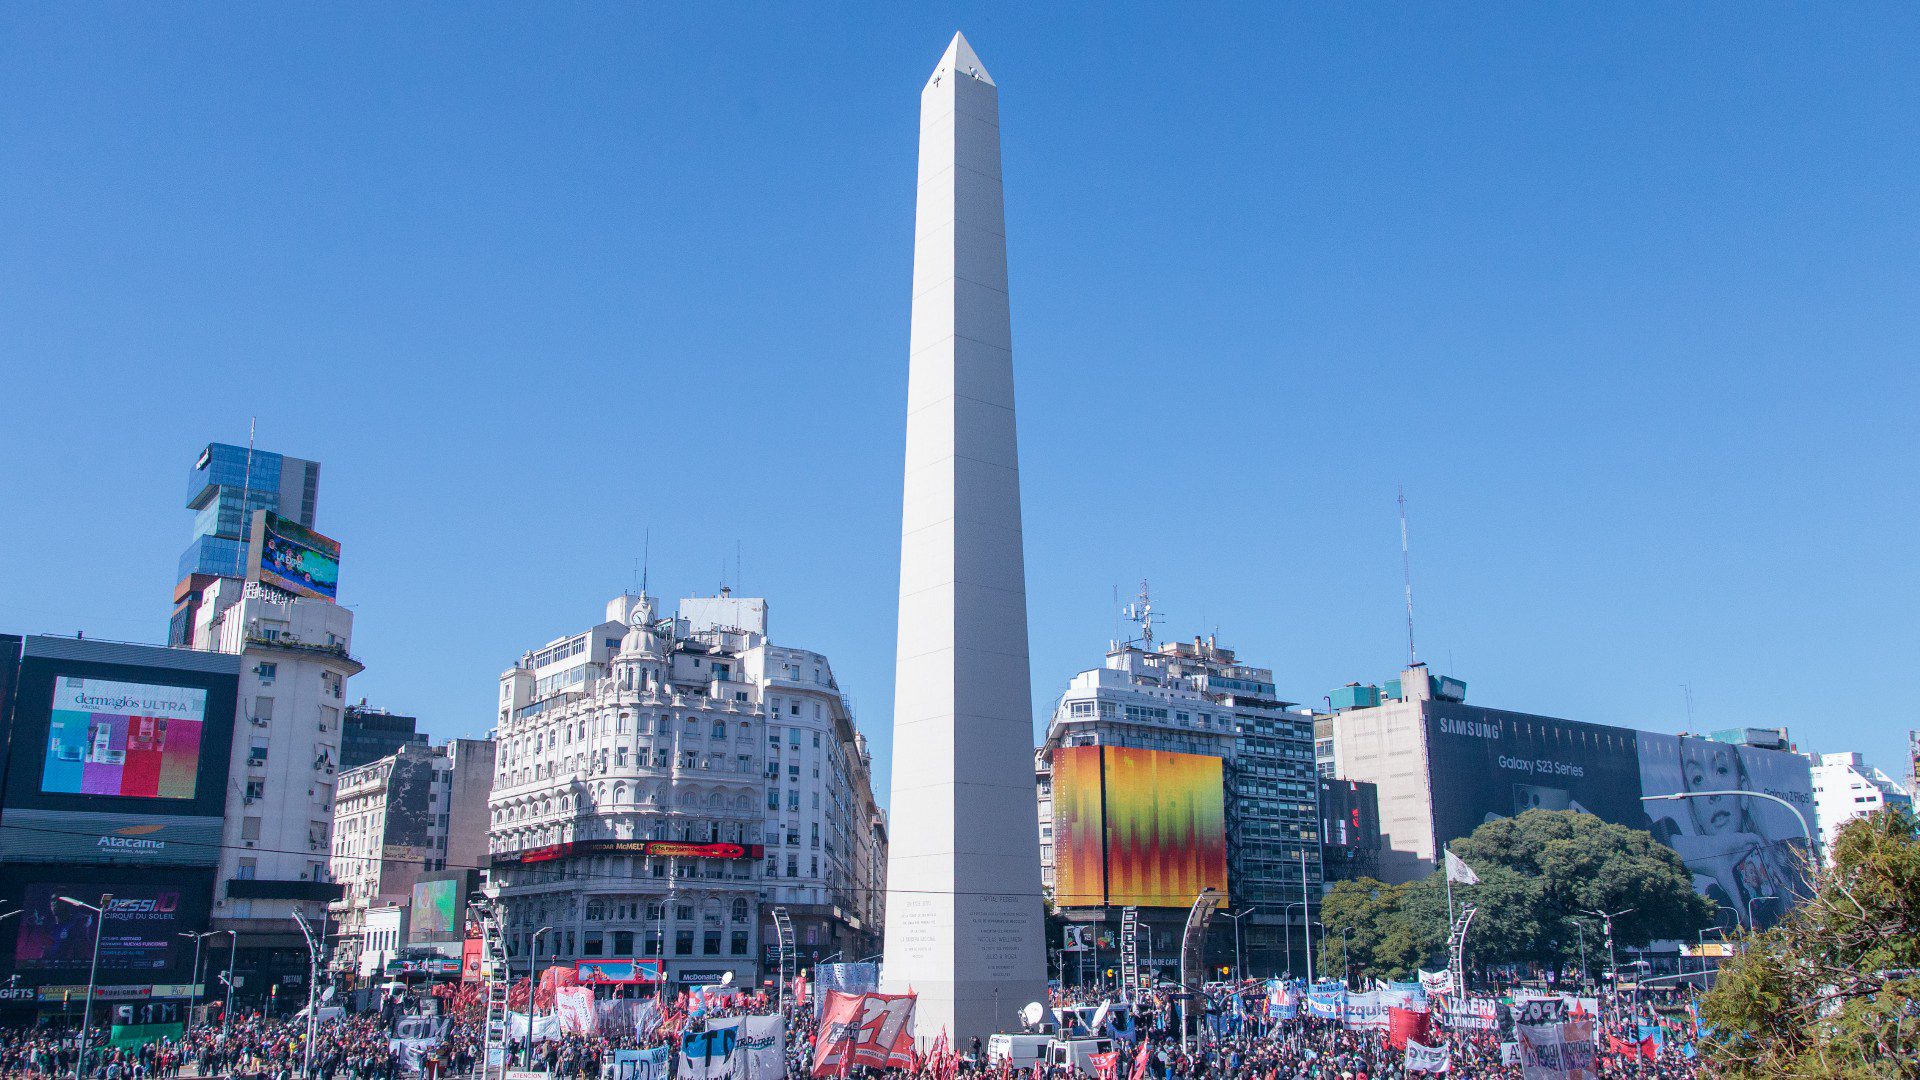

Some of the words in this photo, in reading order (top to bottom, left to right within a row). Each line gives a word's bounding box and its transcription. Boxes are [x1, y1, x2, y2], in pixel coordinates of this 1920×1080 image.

[143, 699, 188, 712] ULTRA
[1440, 717, 1499, 739] SAMSUNG
[1499, 755, 1534, 775] Galaxy
[1537, 759, 1553, 773] S23
[1555, 761, 1584, 777] Series
[97, 836, 165, 849] Atacama
[104, 912, 134, 921] CIRQUE
